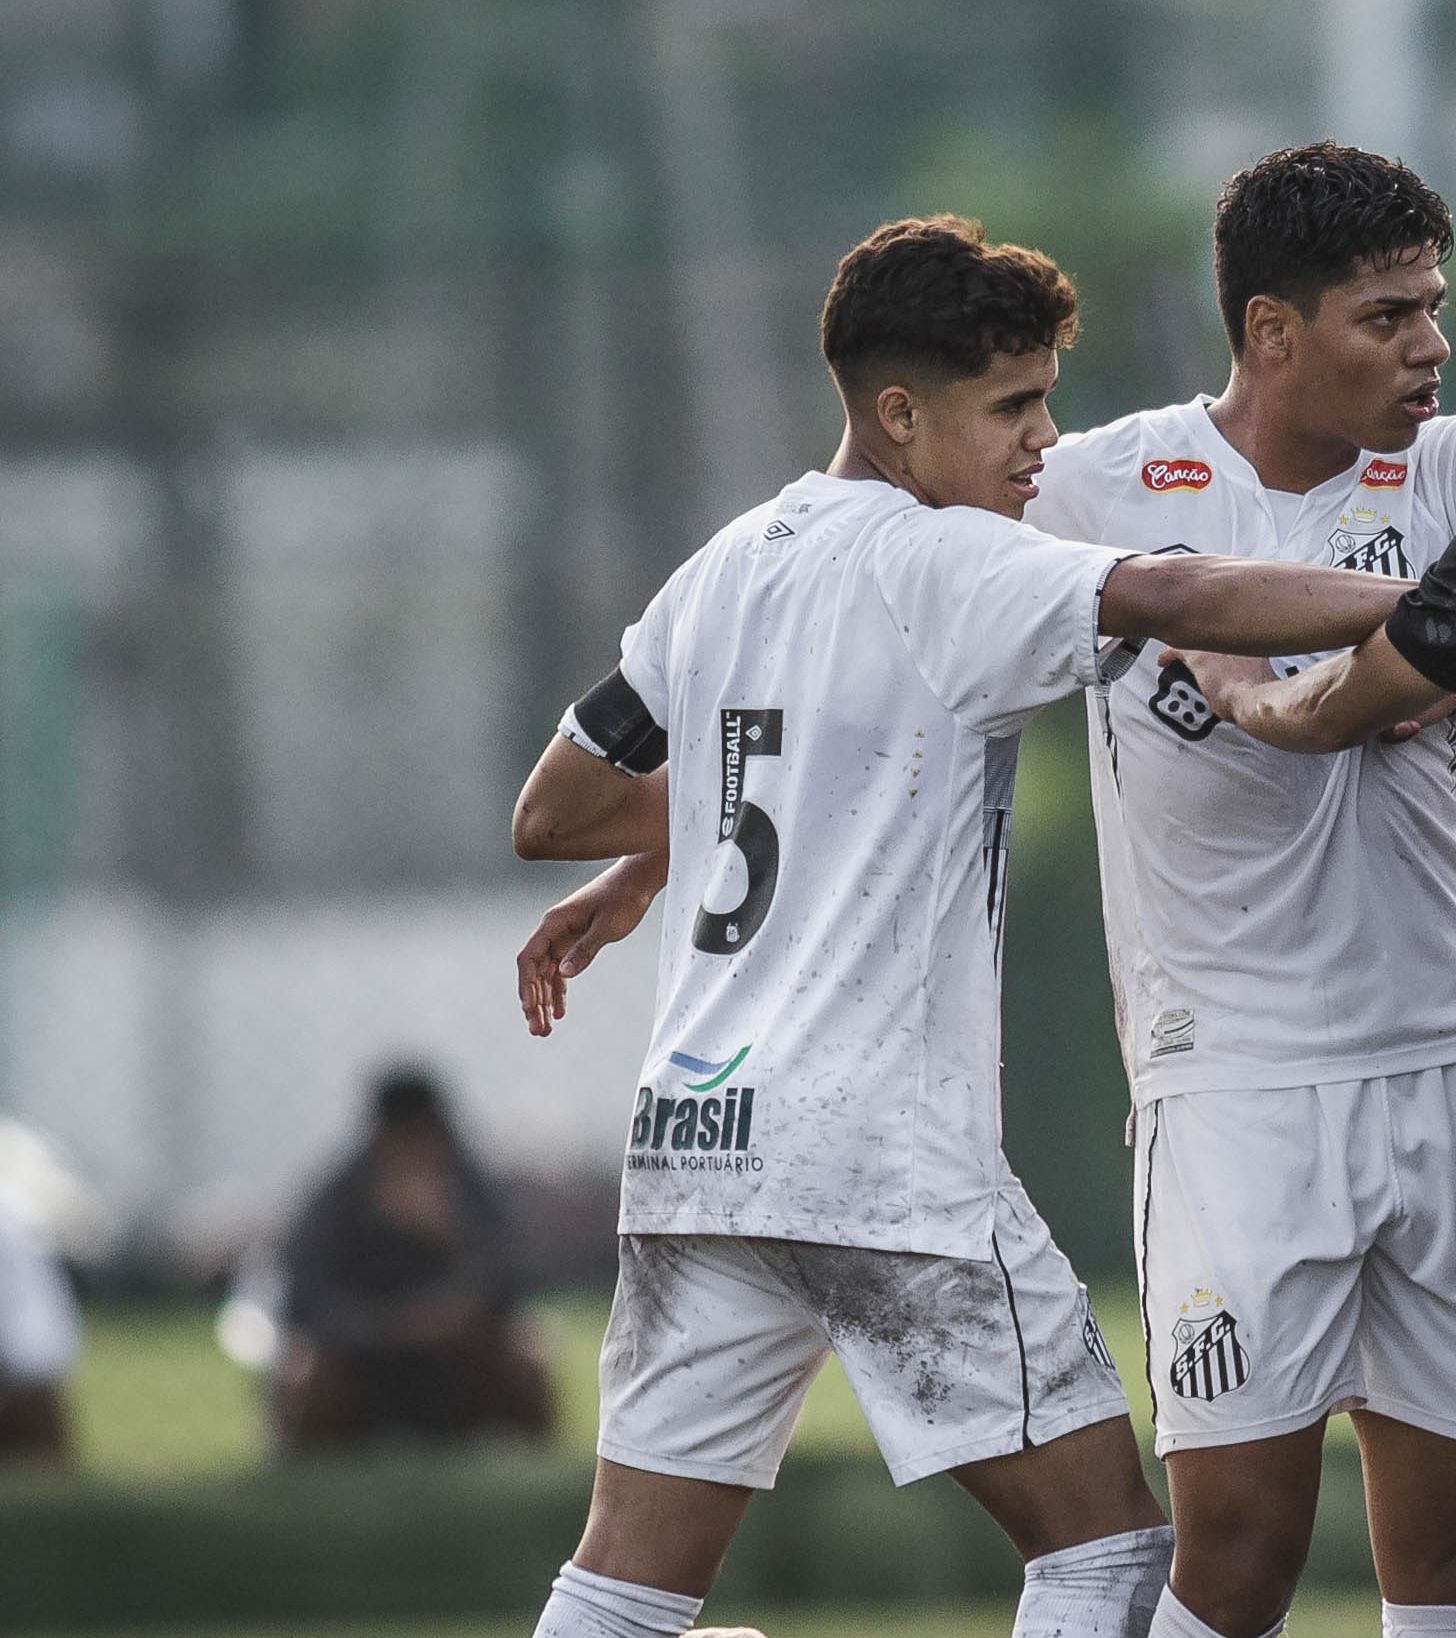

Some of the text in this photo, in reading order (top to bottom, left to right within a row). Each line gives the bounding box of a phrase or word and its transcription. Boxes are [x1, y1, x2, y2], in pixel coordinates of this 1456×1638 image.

[1147, 464, 1209, 489] Canção
[1361, 467, 1406, 482] anção
[691, 708, 783, 956] 5
[630, 1086, 756, 1151] Brasil
[626, 1152, 765, 1173] ERMINAL PORTUÁRIO
